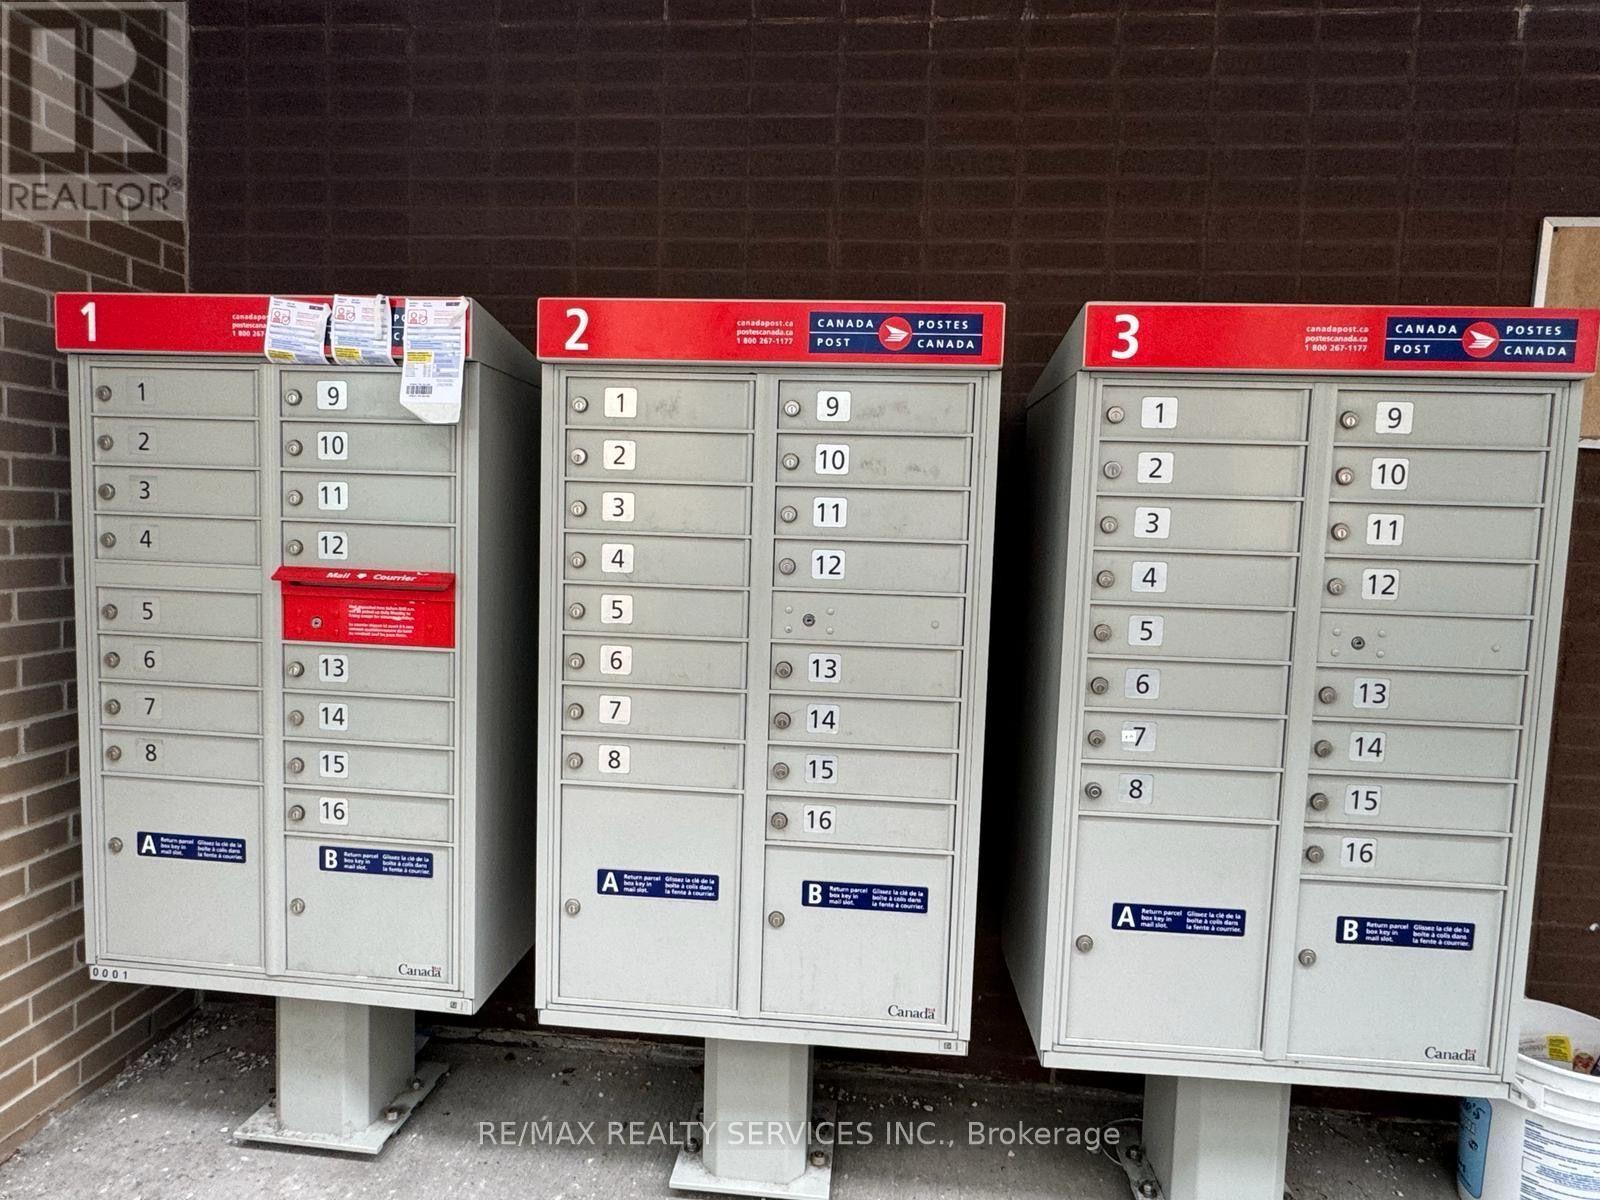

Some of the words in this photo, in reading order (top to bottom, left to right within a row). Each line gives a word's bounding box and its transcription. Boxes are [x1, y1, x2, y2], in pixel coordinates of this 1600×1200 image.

[80, 302, 97, 342] 1
[232, 313, 267, 322] canadapo
[232, 322, 267, 330] postescana
[737, 320, 794, 329] canadapost.ca
[817, 319, 874, 329] CANADA
[918, 320, 969, 330] POSTES
[564, 308, 589, 351] 2
[736, 328, 794, 337] postescanada.ca
[1111, 314, 1140, 359] 3
[1305, 325, 1369, 334] canadapost.ca
[1305, 335, 1368, 344] postescanada.ca
[1395, 324, 1458, 335] CANADA
[1506, 325, 1562, 336] POSTES
[736, 337, 741, 345] 1
[743, 337, 757, 345] 800
[759, 337, 794, 345] 267-1177
[817, 337, 851, 347] POST
[917, 339, 975, 349] CANADA
[1311, 344, 1327, 352] 800
[1330, 344, 1368, 352] 267-1177
[1393, 344, 1431, 354] POST
[1504, 345, 1567, 356] CANADA
[137, 382, 145, 402] 1
[327, 386, 340, 406] 9
[616, 393, 624, 413] 1
[826, 396, 839, 417] 9
[1155, 402, 1164, 424] 1
[1388, 407, 1402, 429] 9
[138, 431, 150, 451] 2
[320, 435, 344, 455] 10
[613, 445, 626, 465] 2
[819, 449, 845, 470] 10
[1148, 457, 1162, 479] 2
[1378, 463, 1406, 485] 10
[139, 480, 150, 500] 3
[321, 485, 341, 505] 11
[612, 497, 625, 517] 3
[817, 502, 840, 523] 11
[1145, 512, 1159, 534] 3
[1373, 519, 1397, 541] 11
[139, 529, 152, 548] 4
[321, 535, 344, 555] 12
[611, 548, 625, 568] 4
[816, 555, 841, 575] 12
[326, 571, 351, 579] Mail
[372, 574, 417, 582] Courrier
[1142, 567, 1157, 588] 4
[1368, 574, 1396, 596] 12
[142, 601, 153, 621] 5
[611, 599, 623, 620] 5
[1140, 620, 1153, 641] 5
[143, 650, 156, 669] 6
[322, 658, 344, 678] 13
[610, 650, 623, 670] 6
[812, 658, 837, 679] 13
[1136, 673, 1150, 695] 6
[1359, 683, 1387, 704] 13
[144, 697, 156, 715] 7
[321, 706, 345, 726] 14
[609, 700, 622, 720] 7
[810, 709, 836, 730] 14
[1133, 726, 1146, 747] 7
[145, 743, 157, 762] 8
[1355, 736, 1383, 758] 14
[322, 754, 345, 774] 15
[608, 749, 621, 769] 8
[809, 759, 834, 780] 15
[1128, 779, 1143, 799] 8
[1351, 790, 1378, 811] 15
[322, 801, 345, 821] 16
[807, 810, 832, 830] 16
[142, 834, 157, 854] A
[1346, 842, 1373, 864] 16
[325, 849, 338, 869] B
[601, 871, 619, 892] A
[808, 883, 822, 904] B
[1117, 905, 1136, 928] A
[1343, 919, 1359, 941] B
[398, 963, 441, 977] Canada
[888, 1004, 935, 1020] Canada
[1425, 1046, 1476, 1061] Canada
